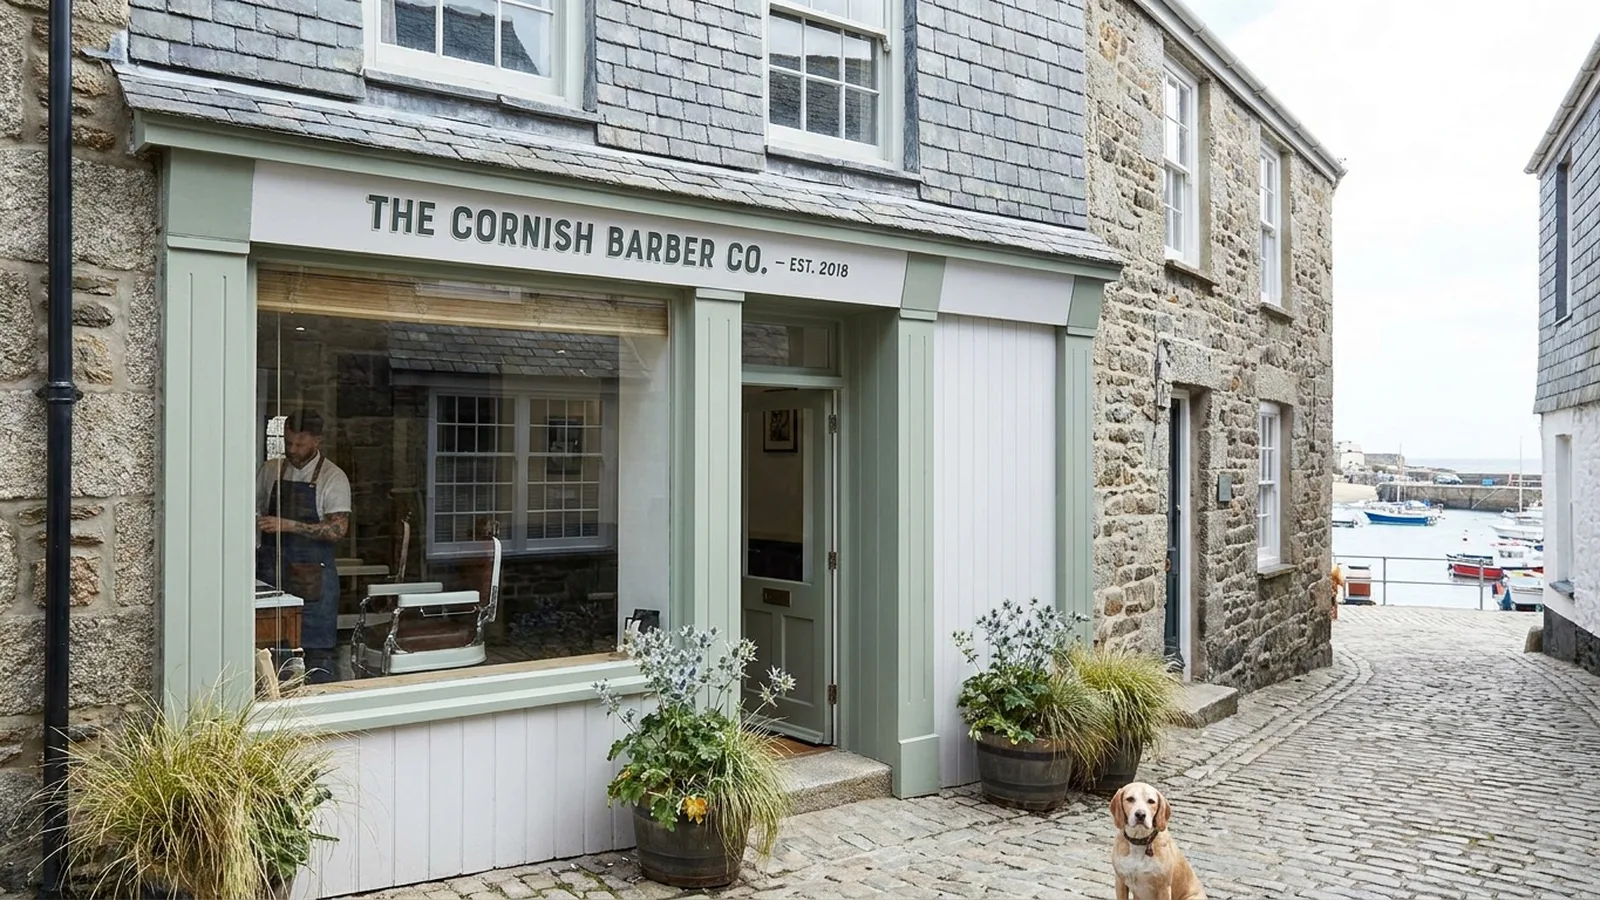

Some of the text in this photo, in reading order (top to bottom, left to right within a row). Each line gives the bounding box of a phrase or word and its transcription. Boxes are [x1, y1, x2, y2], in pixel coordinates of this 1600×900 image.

[366, 194, 436, 236] THE
[451, 205, 594, 255] CORNISH
[606, 225, 716, 269] BARBER
[726, 242, 768, 276] CO.
[788, 257, 816, 275] EST.
[818, 261, 850, 279] 2018
